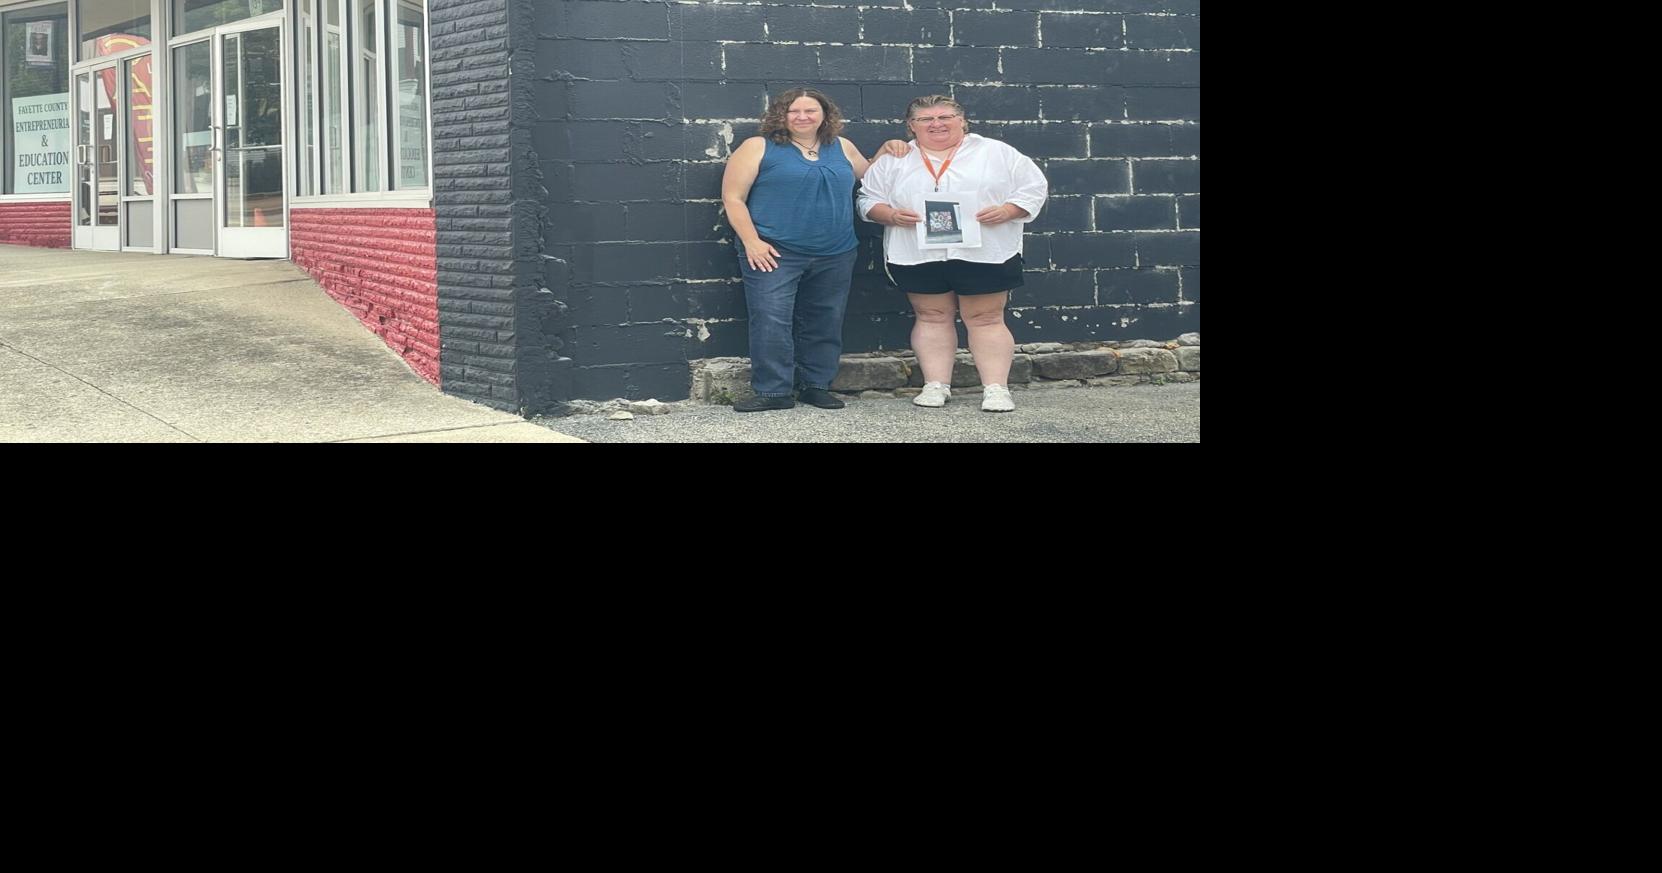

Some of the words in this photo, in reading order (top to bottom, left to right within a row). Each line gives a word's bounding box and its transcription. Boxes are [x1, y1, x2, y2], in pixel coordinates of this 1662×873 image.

[18, 104, 43, 114] FAYETTE
[44, 102, 68, 112] COUNTY
[16, 118, 70, 132] ENTREPRENEURIA
[41, 134, 49, 147] &
[18, 151, 69, 167] EDUCATION
[27, 171, 62, 185] CENTER
